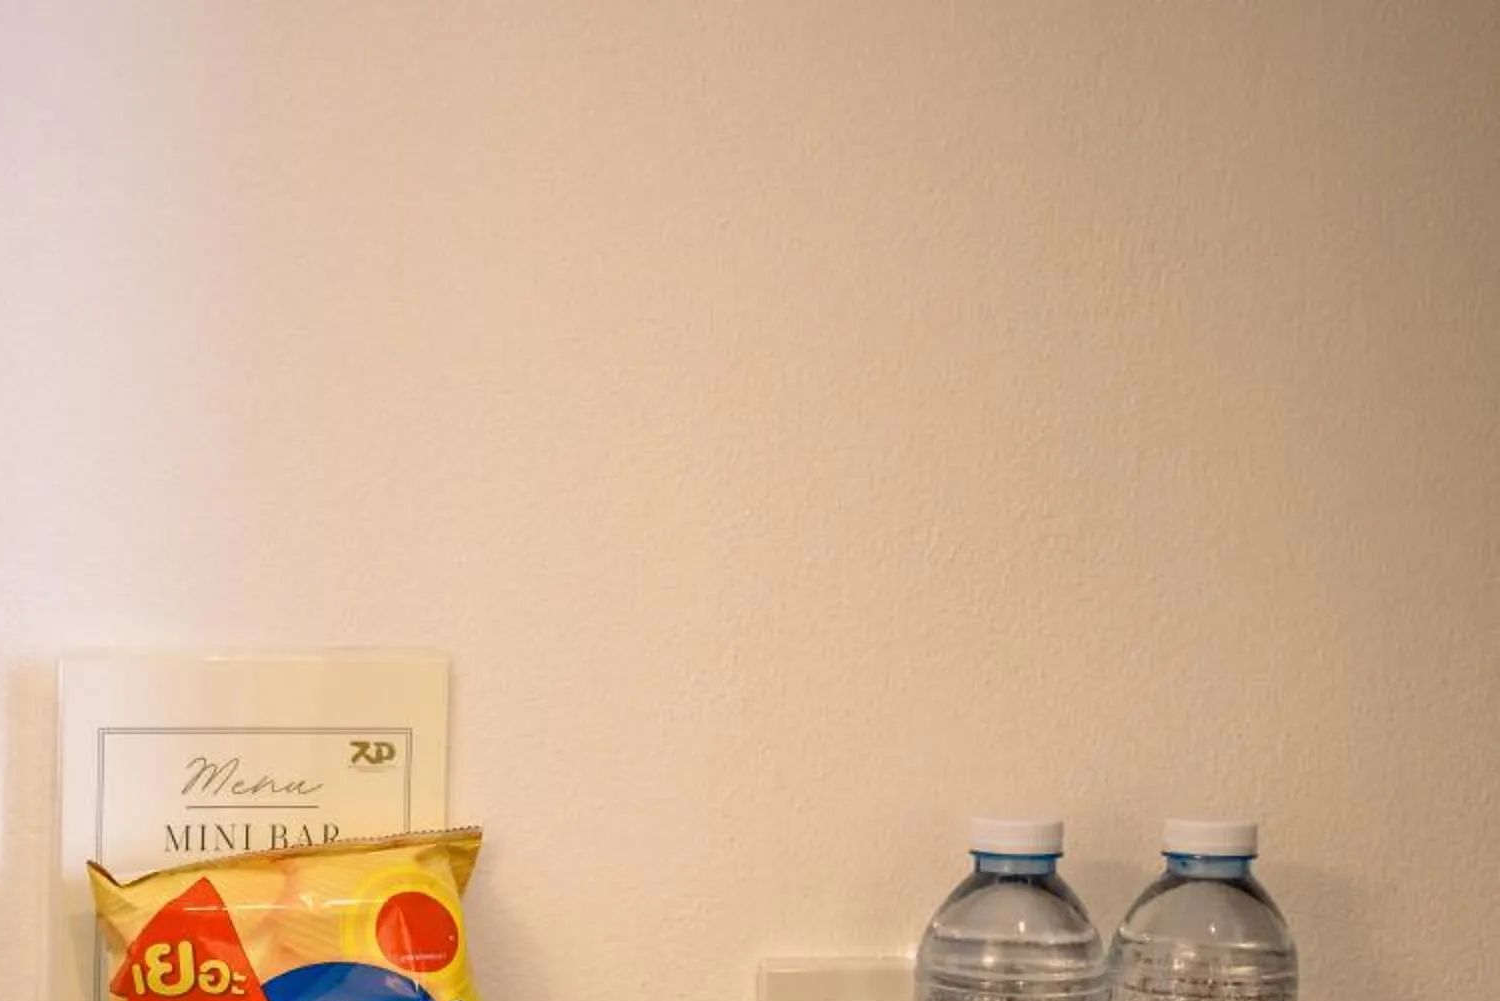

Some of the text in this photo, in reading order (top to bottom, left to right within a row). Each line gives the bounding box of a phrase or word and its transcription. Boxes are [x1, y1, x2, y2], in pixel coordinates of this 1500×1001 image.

[181, 756, 324, 795] Menu
[164, 822, 341, 852] MINI BAR
[131, 940, 247, 996] เยอะ
